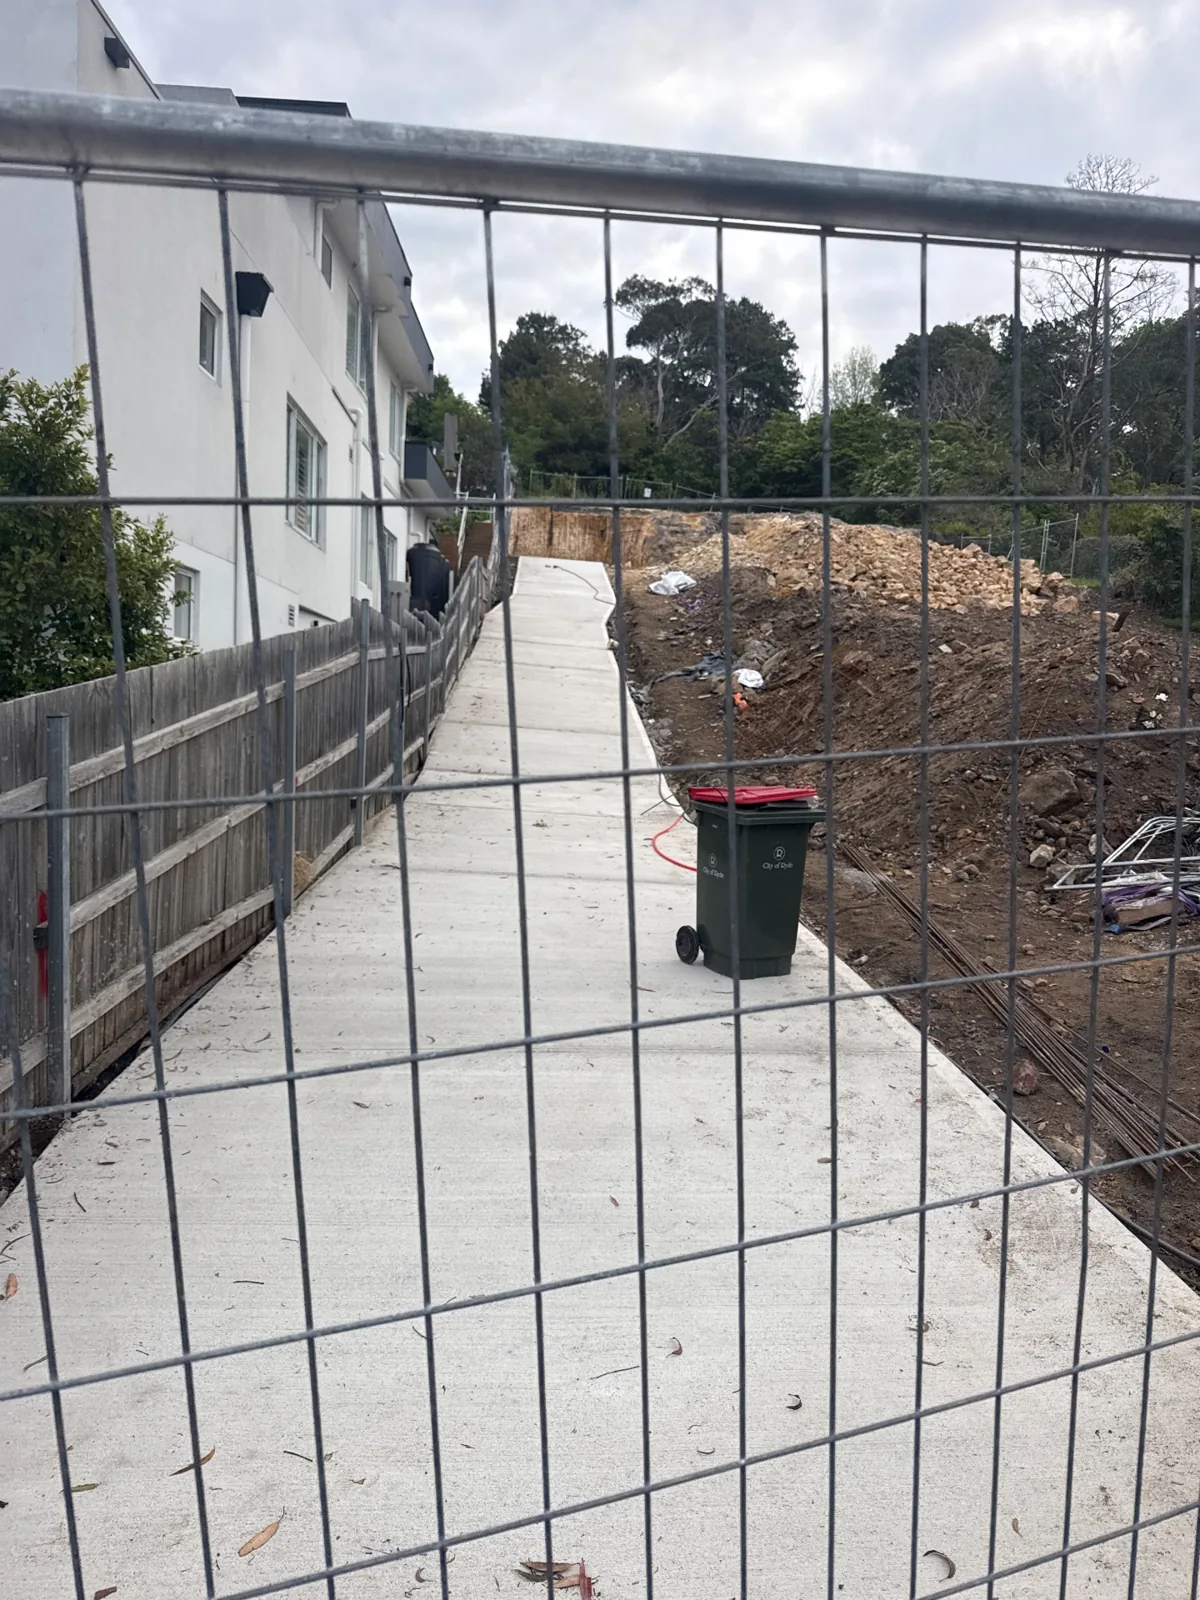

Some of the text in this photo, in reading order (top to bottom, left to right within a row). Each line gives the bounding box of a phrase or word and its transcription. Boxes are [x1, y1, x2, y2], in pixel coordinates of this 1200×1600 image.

[762, 862, 773, 870] City
[781, 862, 793, 870] Ryde
[714, 870, 724, 879] Ryde
